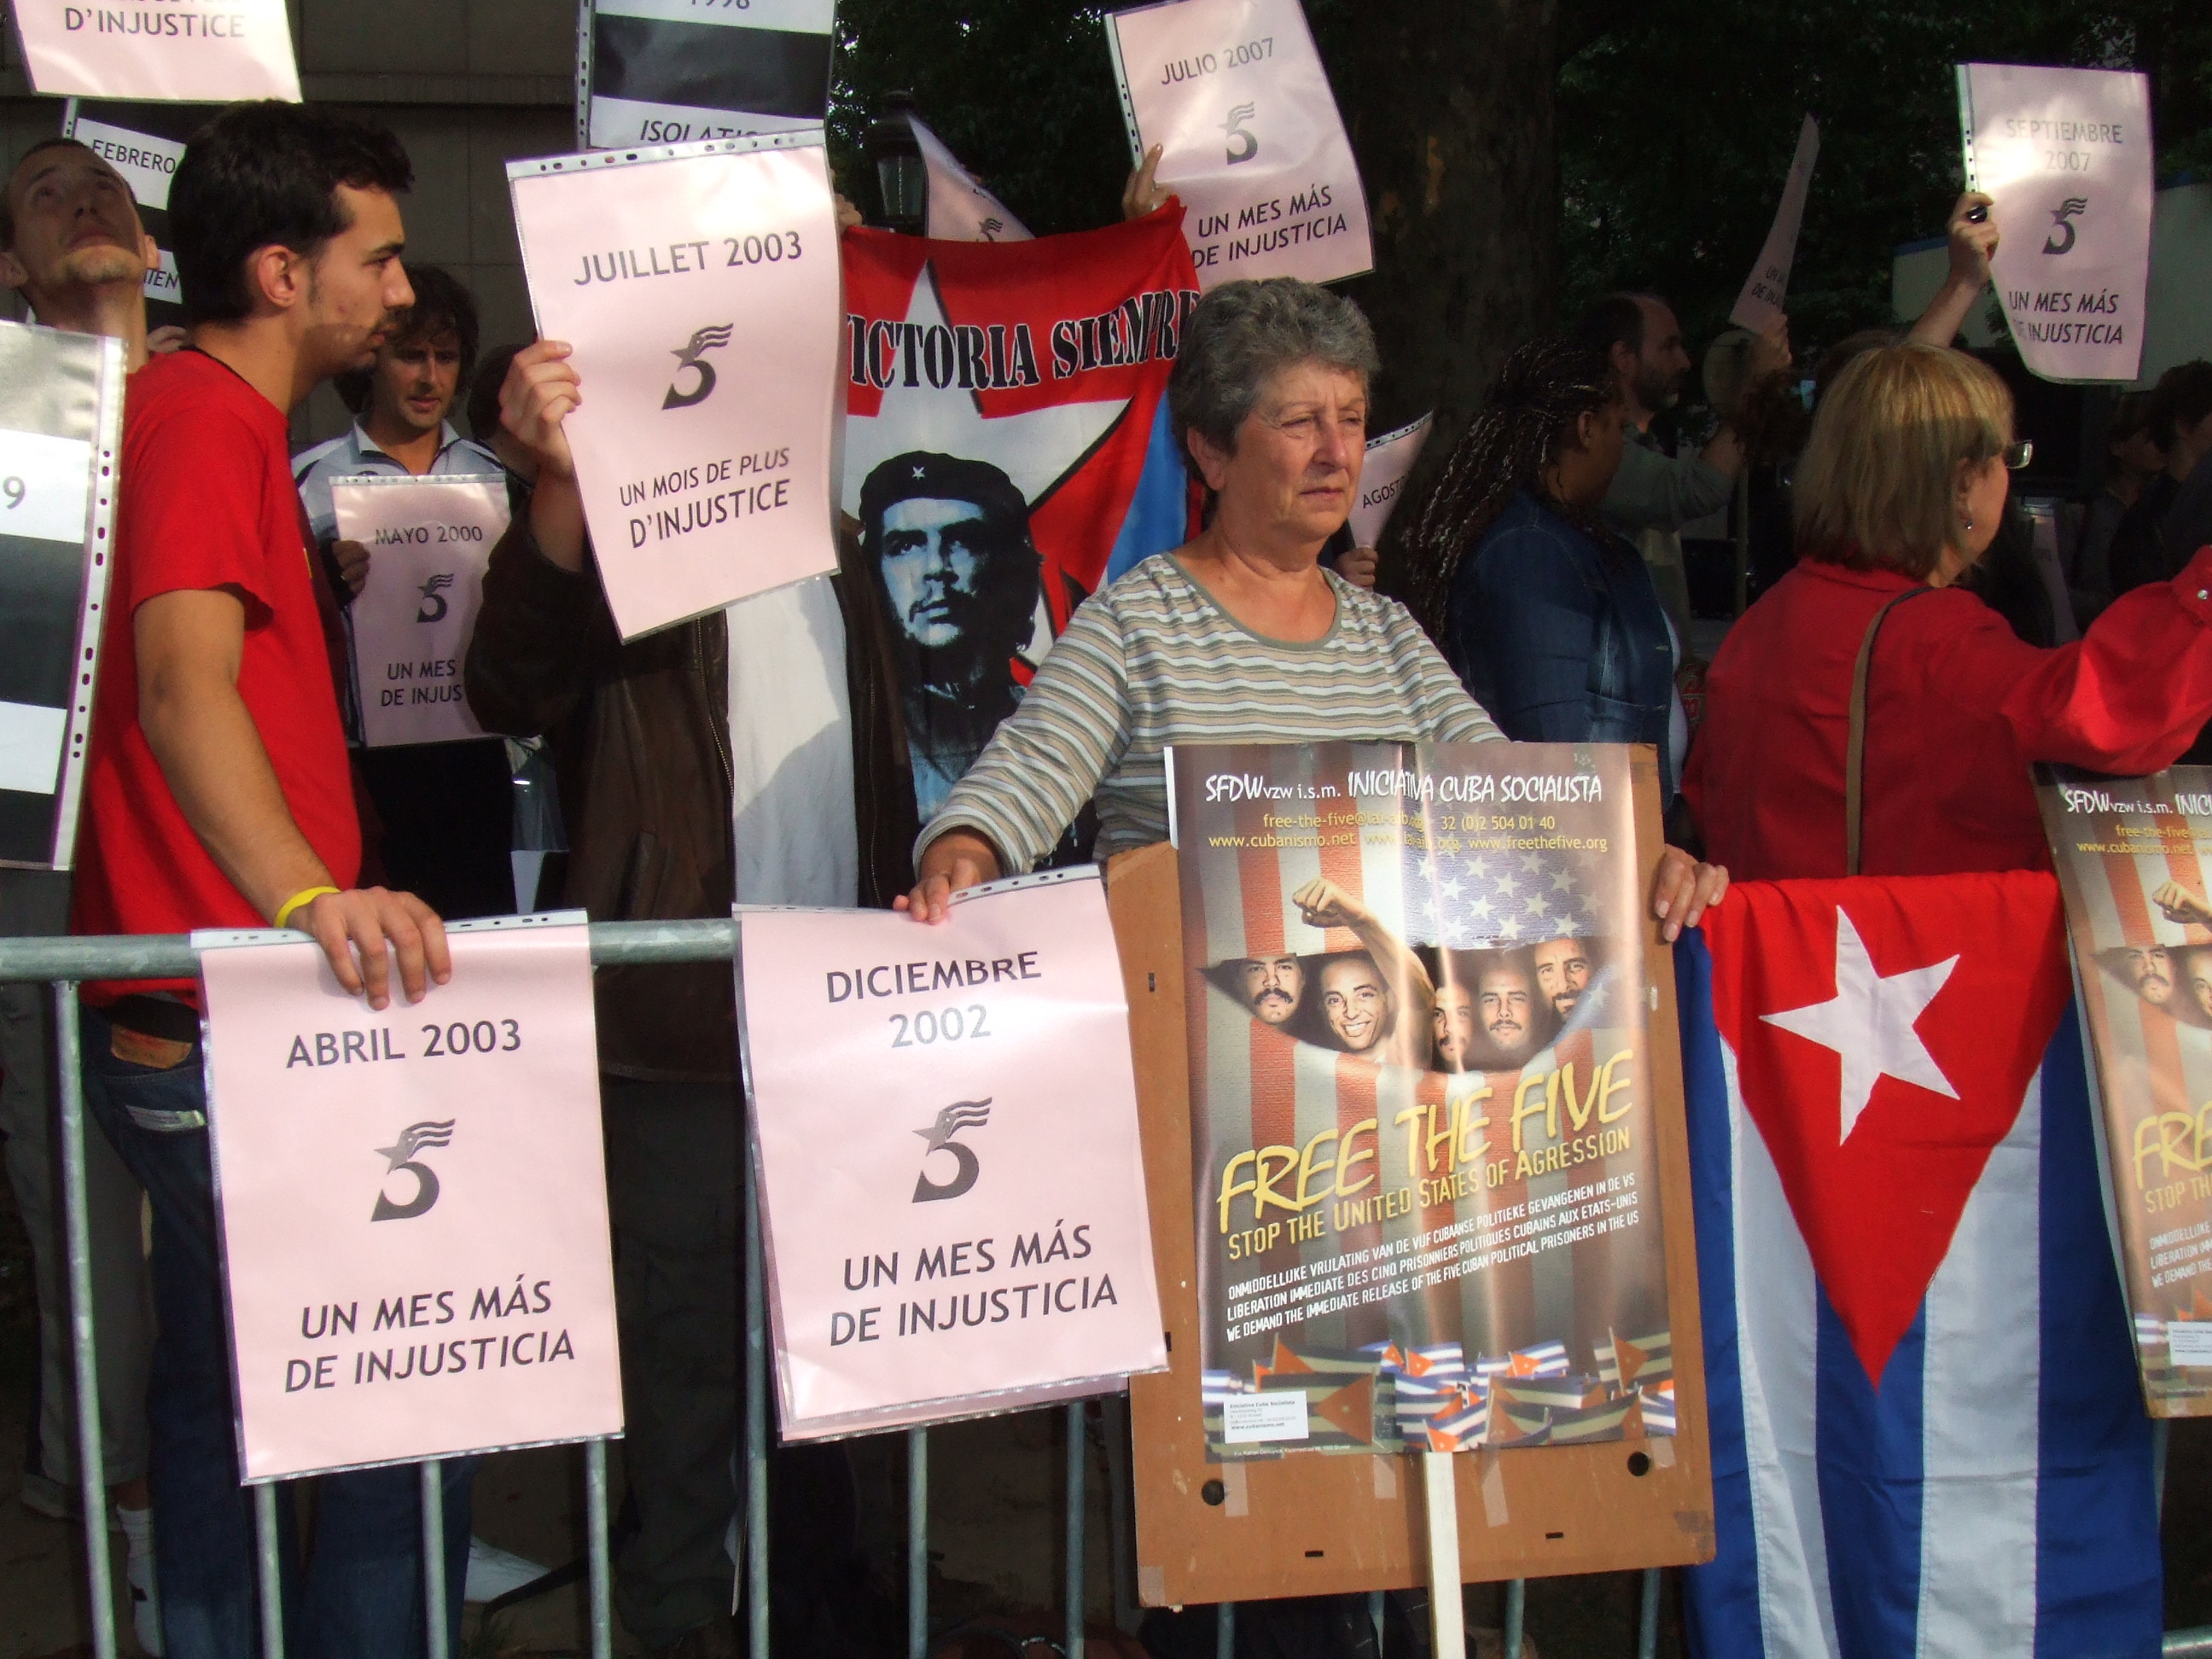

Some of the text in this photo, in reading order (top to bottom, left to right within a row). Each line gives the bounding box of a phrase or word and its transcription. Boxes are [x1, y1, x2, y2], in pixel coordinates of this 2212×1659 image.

[1161, 37, 1273, 84] JULIO 2007
[92, 139, 176, 173] FEBRERO
[2005, 119, 2123, 144] SEPTIEMBRE
[2045, 150, 2091, 172] 2007
[1198, 183, 1332, 237] UN MES MÁS
[573, 230, 802, 286] JUILLET 2003
[1192, 213, 1348, 269] DE INJUSTICIA
[2009, 288, 2119, 314] UN MES MÁS
[847, 312, 1040, 390] ICTORIA
[2029, 323, 2122, 344] INJUSTICIA
[620, 447, 790, 507] UN MOIS DE PLUS
[375, 526, 483, 545] MAYO 2000
[387, 659, 456, 680] UN MES
[381, 689, 405, 707] DE
[1348, 769, 1434, 802] INICIATIVA
[1440, 775, 1494, 803] CUBA
[1500, 775, 1602, 803] SOCIALISTA
[1208, 833, 1355, 847] www.cubanismo.net
[1469, 835, 1608, 852] www.freethefive.org
[1441, 816, 1456, 830] 32
[1491, 817, 1515, 830] 504
[1519, 816, 1534, 830] 01
[1539, 816, 1555, 830] 40
[825, 950, 1042, 1004] DICIEMBRE
[286, 1019, 521, 1069] ABRIL 2003
[888, 1004, 992, 1049] 2002
[1217, 1050, 1633, 1234] FREE THE FIVE
[1228, 1126, 1631, 1260] STOP THE UNITED STATES OF AGRESSION
[1372, 1246, 1394, 1261] VAN
[1396, 1238, 1410, 1254] DE
[1434, 1220, 1475, 1243] CUBAANSE
[1476, 1204, 1526, 1229] POLITIEKE
[1528, 1185, 1594, 1214] GEVANGENEN
[1609, 1176, 1621, 1192] DE
[1622, 1173, 1635, 1187] VS
[2145, 1173, 2212, 1214] STOP TH
[843, 1219, 1092, 1291] UN MES MÁS
[1226, 1210, 1639, 1342] WE DEMAND THE IMMEDIATE RELEASE OF THE FIVE CUBAN POLITICAL PRISONERS IN THE US
[1227, 1191, 1638, 1322] LIBERATION IMMEDIATE DES CINQ PRISONNIERS POLITIQUES CUBAINS AUX ETATS-UNIS
[300, 1274, 552, 1340] UN MES MÁS
[830, 1273, 1119, 1347] DE INJUSTICIA
[285, 1329, 575, 1393] DE INJUSTICIA
